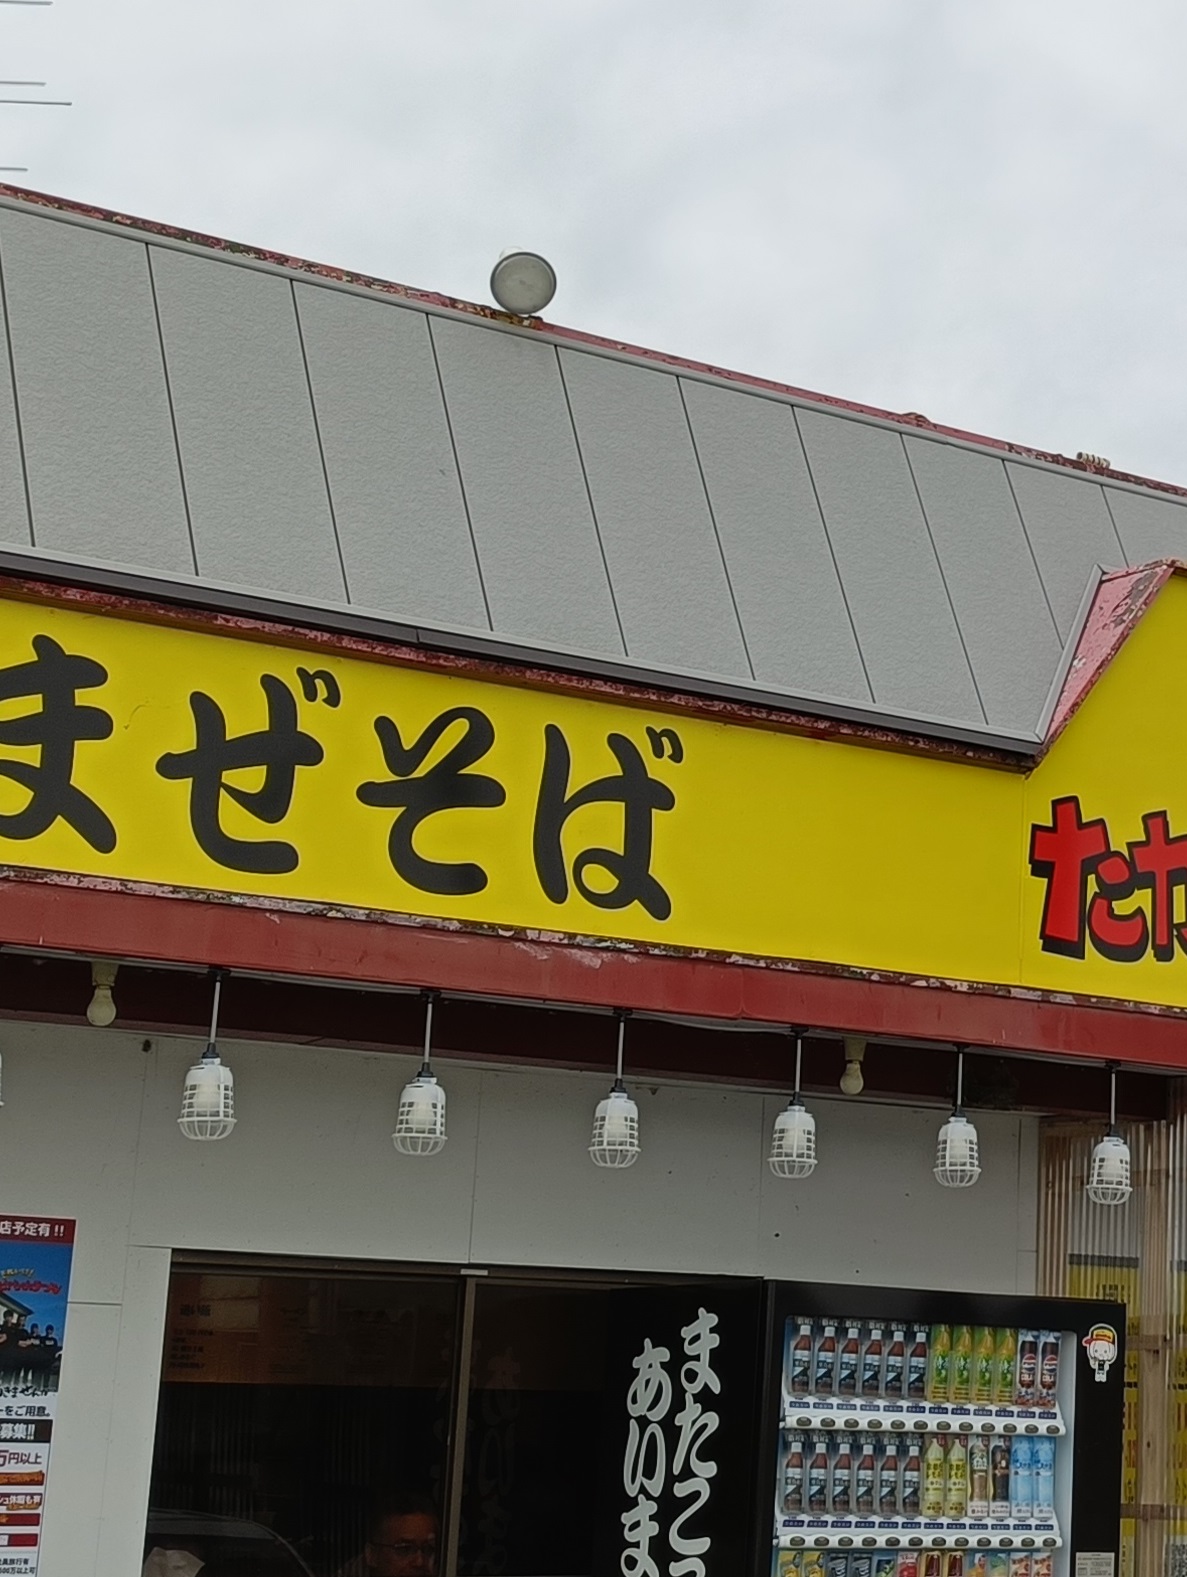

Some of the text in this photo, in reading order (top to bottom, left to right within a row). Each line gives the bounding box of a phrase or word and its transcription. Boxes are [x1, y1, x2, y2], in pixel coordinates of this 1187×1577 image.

[0, 634, 683, 921] まぜそば
[620, 1337, 673, 1577] あいま
[669, 1307, 721, 1577] またこ
